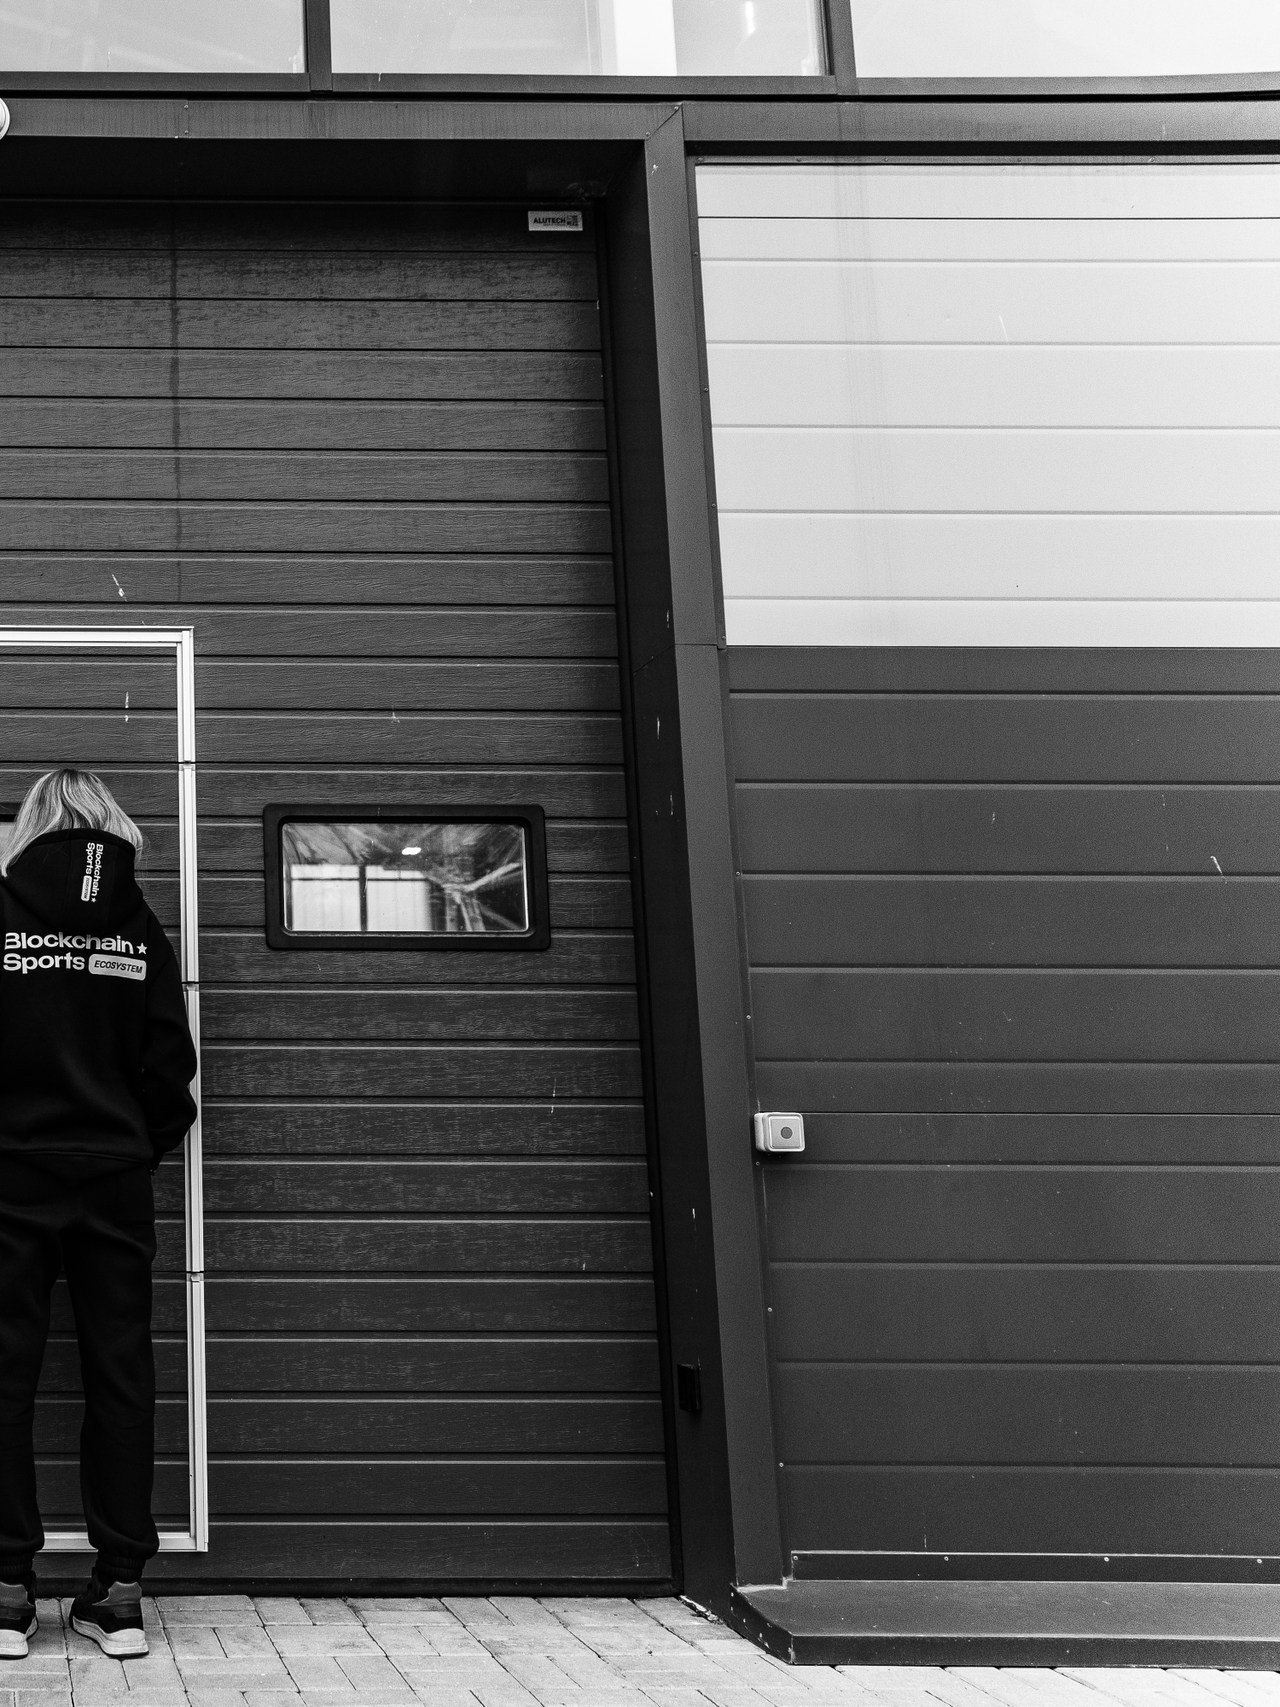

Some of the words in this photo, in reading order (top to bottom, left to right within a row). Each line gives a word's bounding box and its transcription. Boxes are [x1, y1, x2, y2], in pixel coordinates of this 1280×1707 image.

[85, 842, 96, 875] Sports
[91, 843, 104, 897] Blockchain
[4, 932, 134, 954] Blockchain
[3, 952, 85, 974] Sports
[94, 960, 143, 974] ECOSYSTEM
